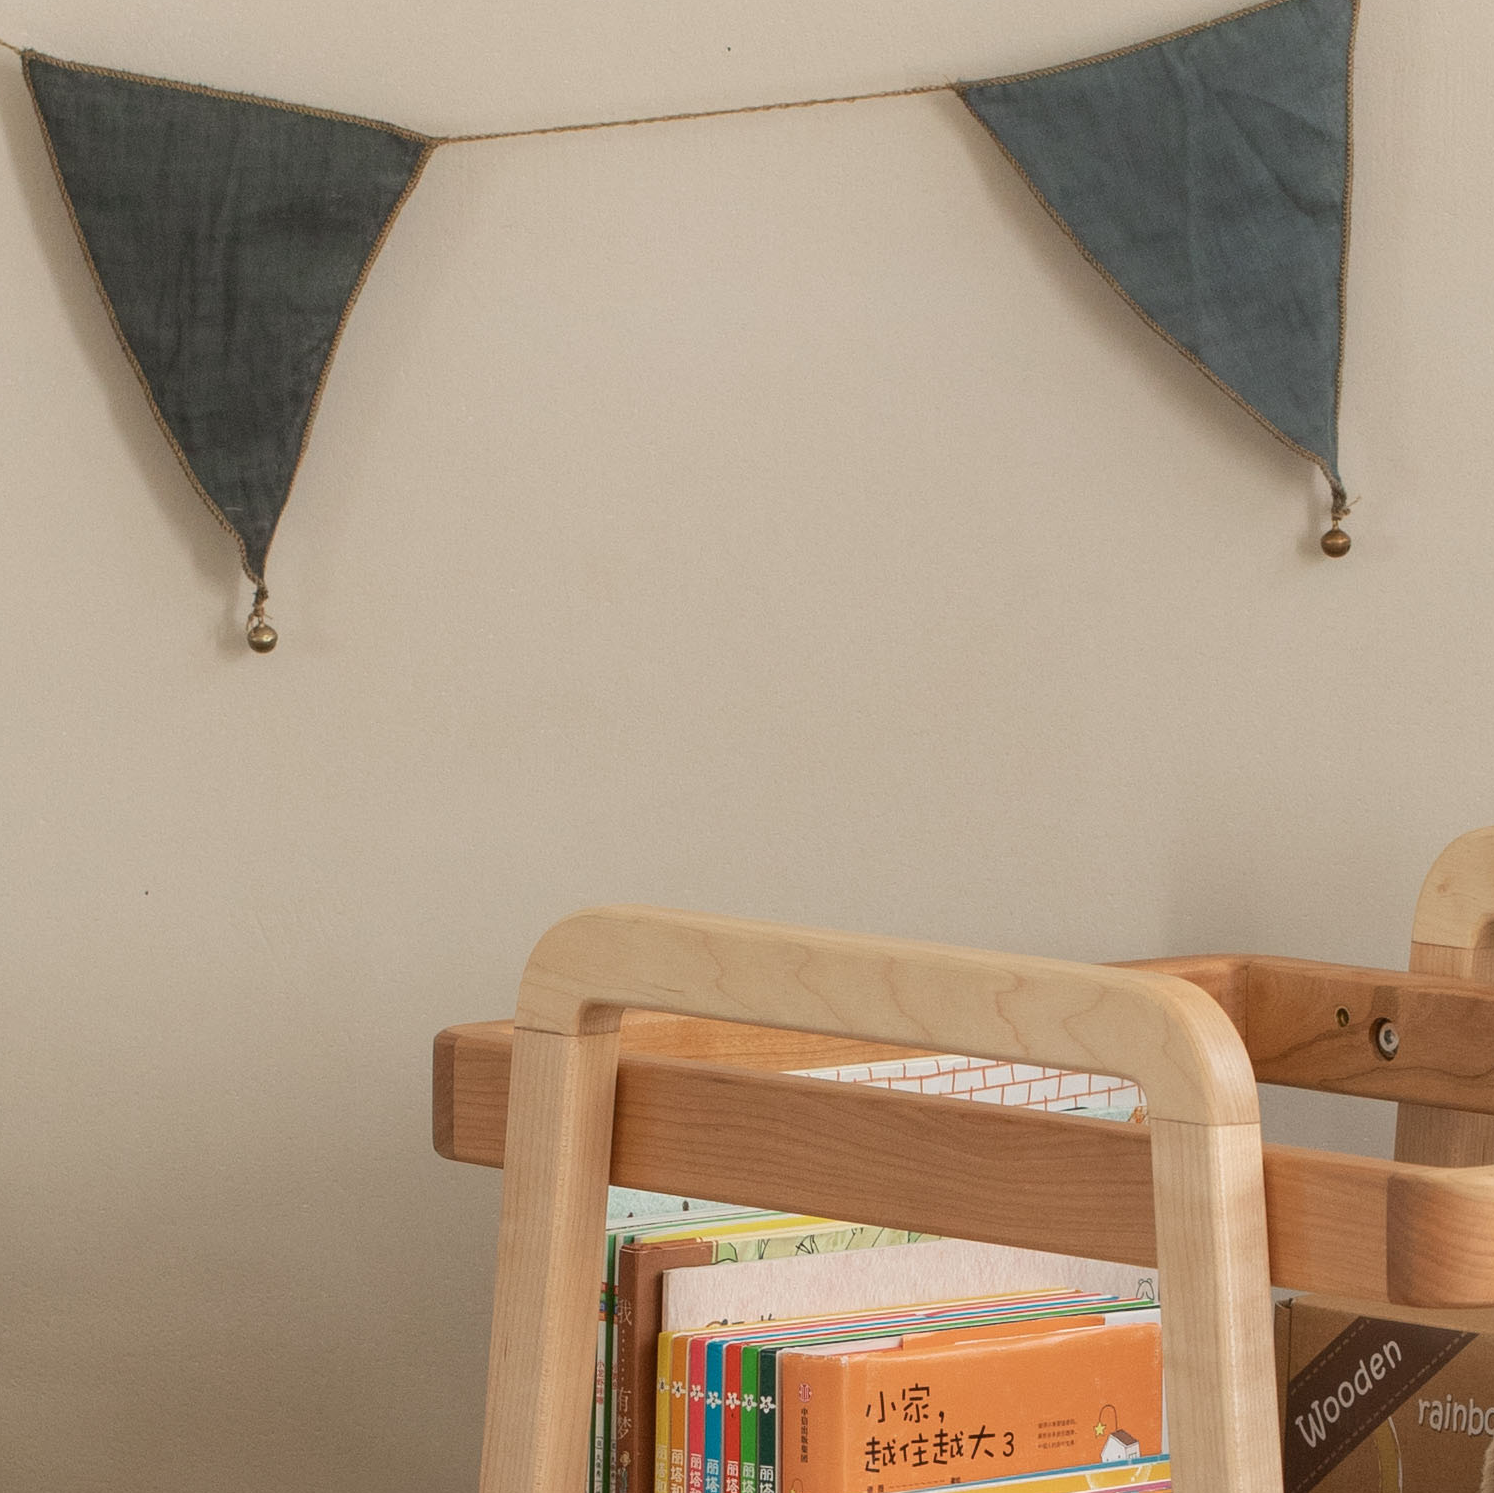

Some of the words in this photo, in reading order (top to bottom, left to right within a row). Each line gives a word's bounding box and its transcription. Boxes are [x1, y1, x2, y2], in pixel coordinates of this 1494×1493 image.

[1294, 1339, 1403, 1449] Wooden
[864, 1425, 1016, 1474] 越住越大3
